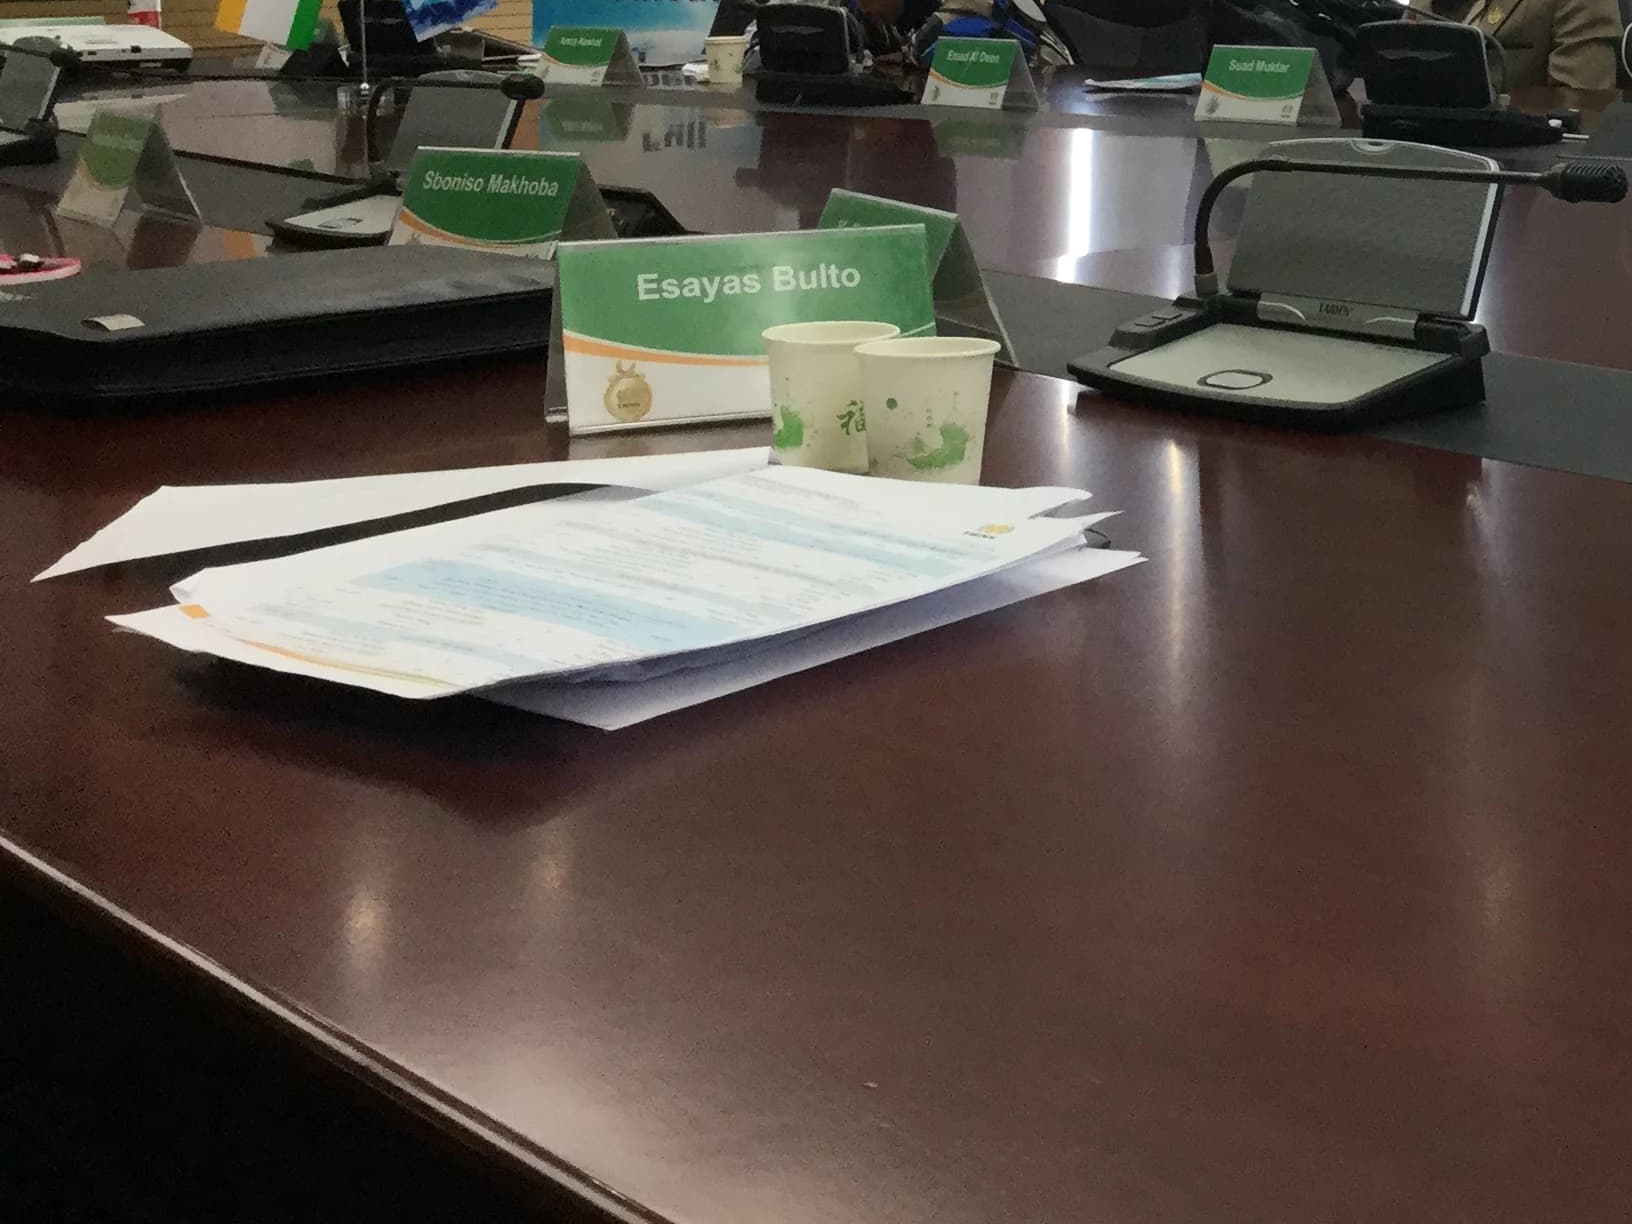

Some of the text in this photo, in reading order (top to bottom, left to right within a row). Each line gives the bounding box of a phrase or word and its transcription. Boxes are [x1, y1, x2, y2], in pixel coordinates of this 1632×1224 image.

[486, 174, 560, 197] Makhoba
[637, 263, 861, 303] Esayas Bulto
